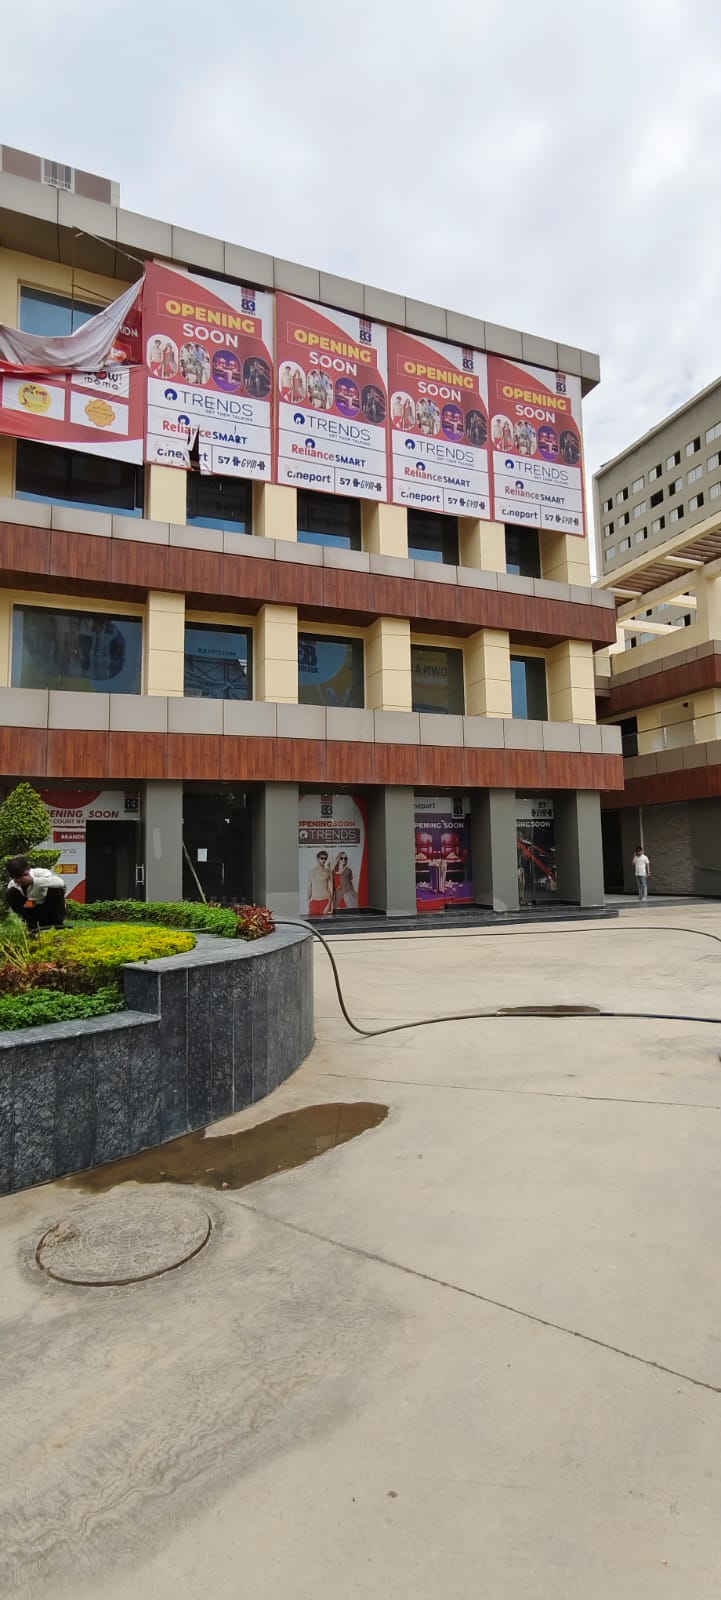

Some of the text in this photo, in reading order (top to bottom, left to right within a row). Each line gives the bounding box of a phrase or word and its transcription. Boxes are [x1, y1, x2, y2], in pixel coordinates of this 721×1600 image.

[241, 298, 256, 312] 83
[165, 300, 255, 333] OPENING
[183, 323, 238, 348] SOON
[359, 330, 372, 342] 83
[294, 329, 371, 363] OPENING
[309, 351, 357, 376] SOON
[462, 359, 474, 370] 83
[404, 361, 474, 389] OPENING
[418, 381, 461, 402] SOON
[502, 385, 567, 411] OPENING
[180, 390, 254, 417] TRENDS
[515, 404, 556, 424] SOON
[307, 415, 371, 441] TRENDS
[218, 455, 231, 465] 57
[416, 440, 474, 463] TRENDS
[515, 460, 569, 481] TRENDS
[339, 477, 351, 486] 57
[447, 497, 458, 505] 57
[544, 513, 554, 521] 57
[88, 810, 119, 818] SOON
[321, 804, 333, 816] 83
[530, 820, 551, 828] SOON
[308, 829, 357, 840] TRENDS
